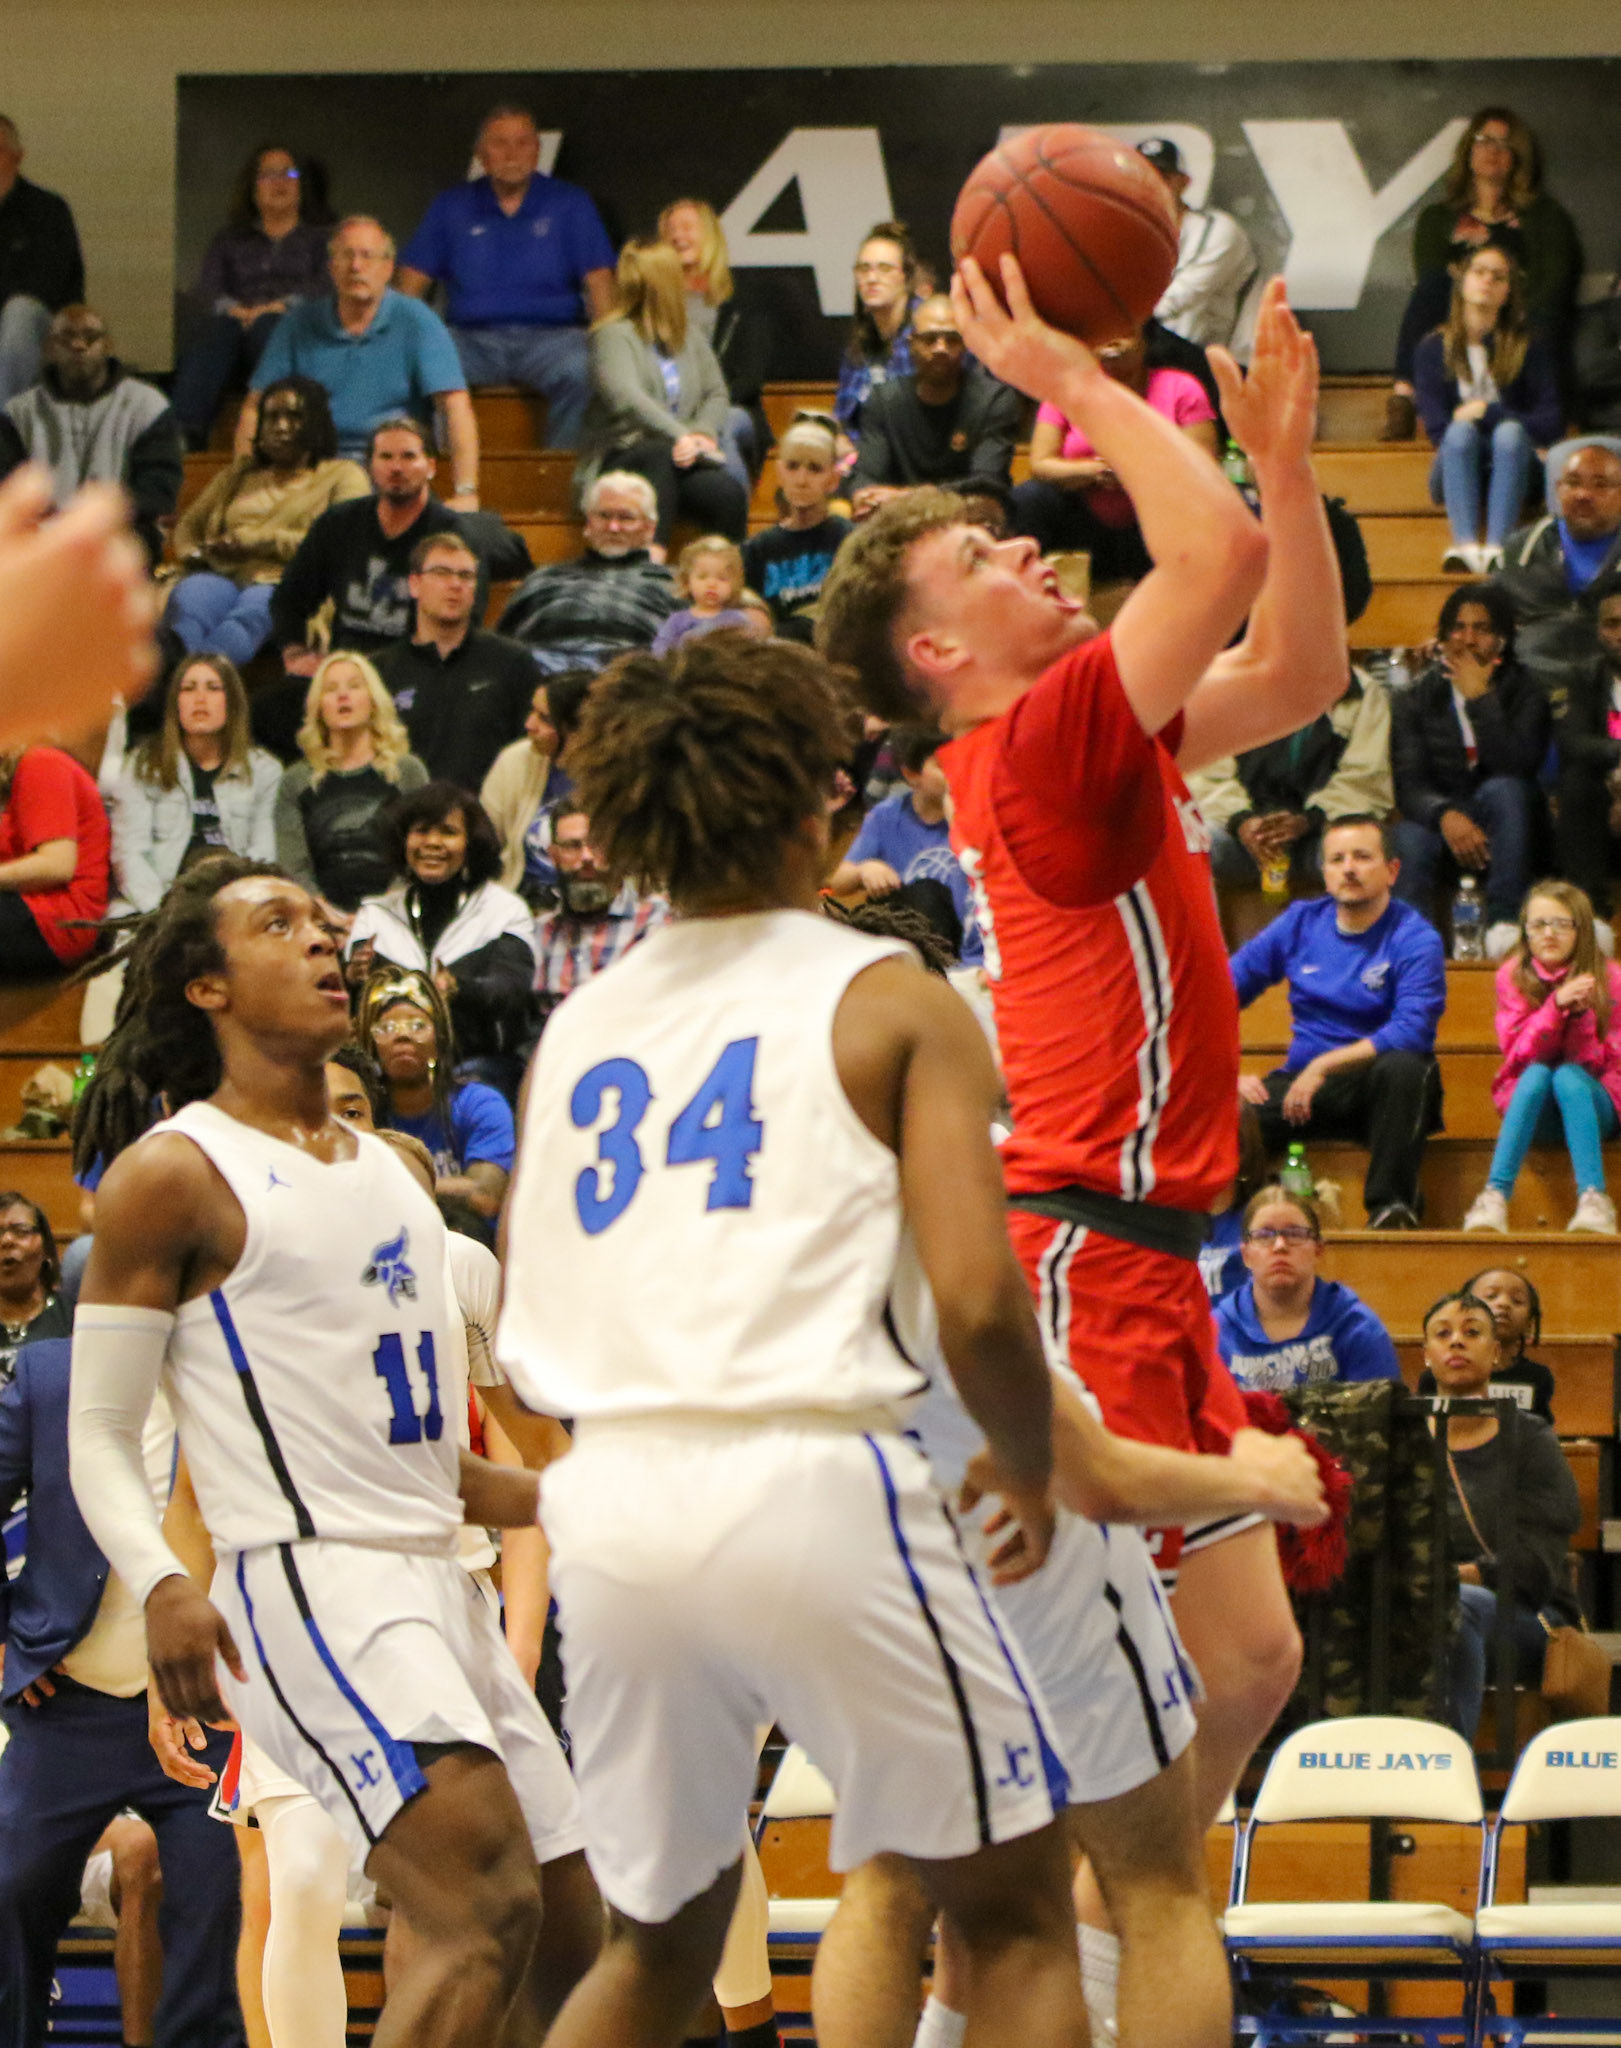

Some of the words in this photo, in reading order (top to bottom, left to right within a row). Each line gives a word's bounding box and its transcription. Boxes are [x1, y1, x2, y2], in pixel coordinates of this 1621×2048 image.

[570, 1036, 763, 1236] 34
[373, 1331, 444, 1445] 11
[1298, 1752, 1371, 1770] BLUE
[1378, 1753, 1452, 1771] JAYS
[1545, 1751, 1618, 1769] BLUE
